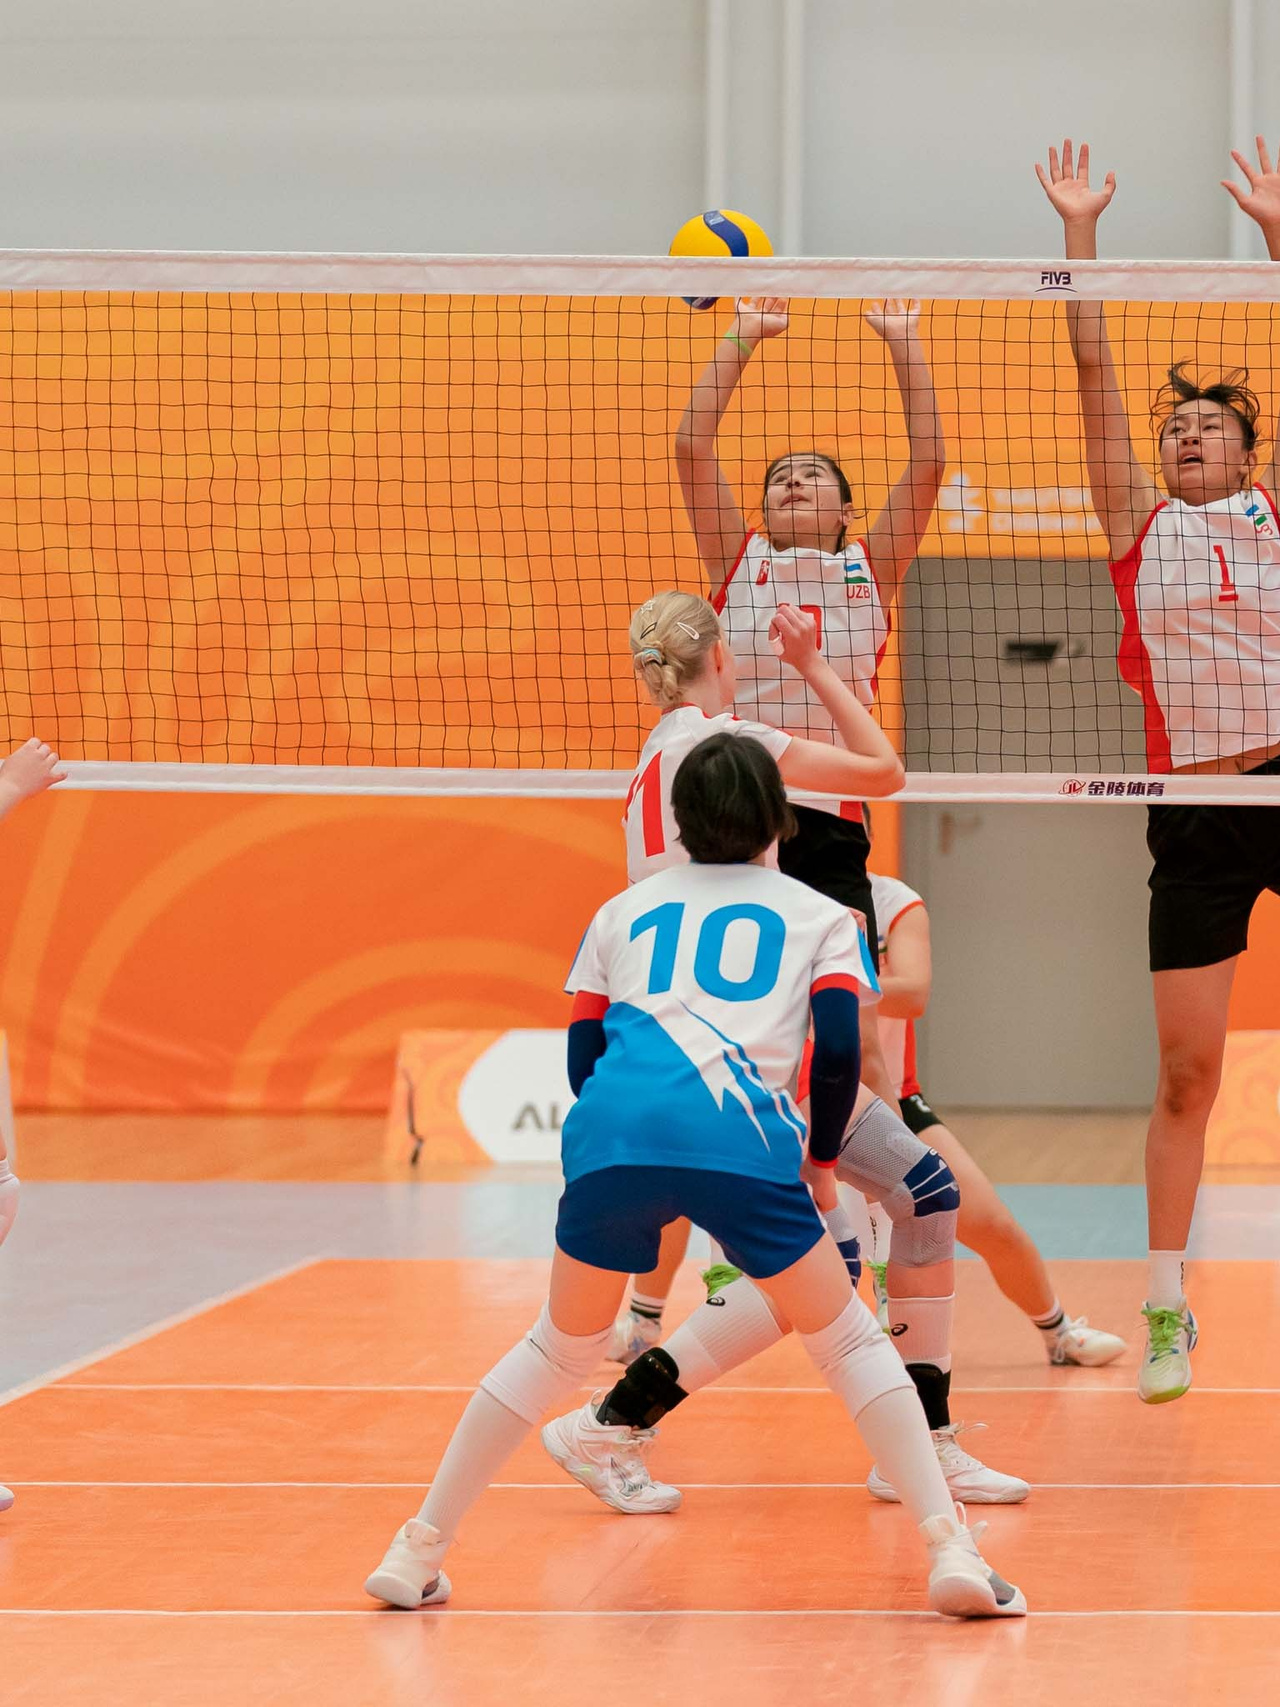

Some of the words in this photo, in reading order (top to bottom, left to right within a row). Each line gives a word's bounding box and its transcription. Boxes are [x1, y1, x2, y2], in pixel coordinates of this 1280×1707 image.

[1041, 271, 1072, 285] FIVB
[1213, 545, 1237, 594] 1
[845, 585, 871, 599] UZB
[1088, 781, 1165, 796] 金陵体育
[629, 902, 787, 1002] 10
[511, 1102, 562, 1131] AL
